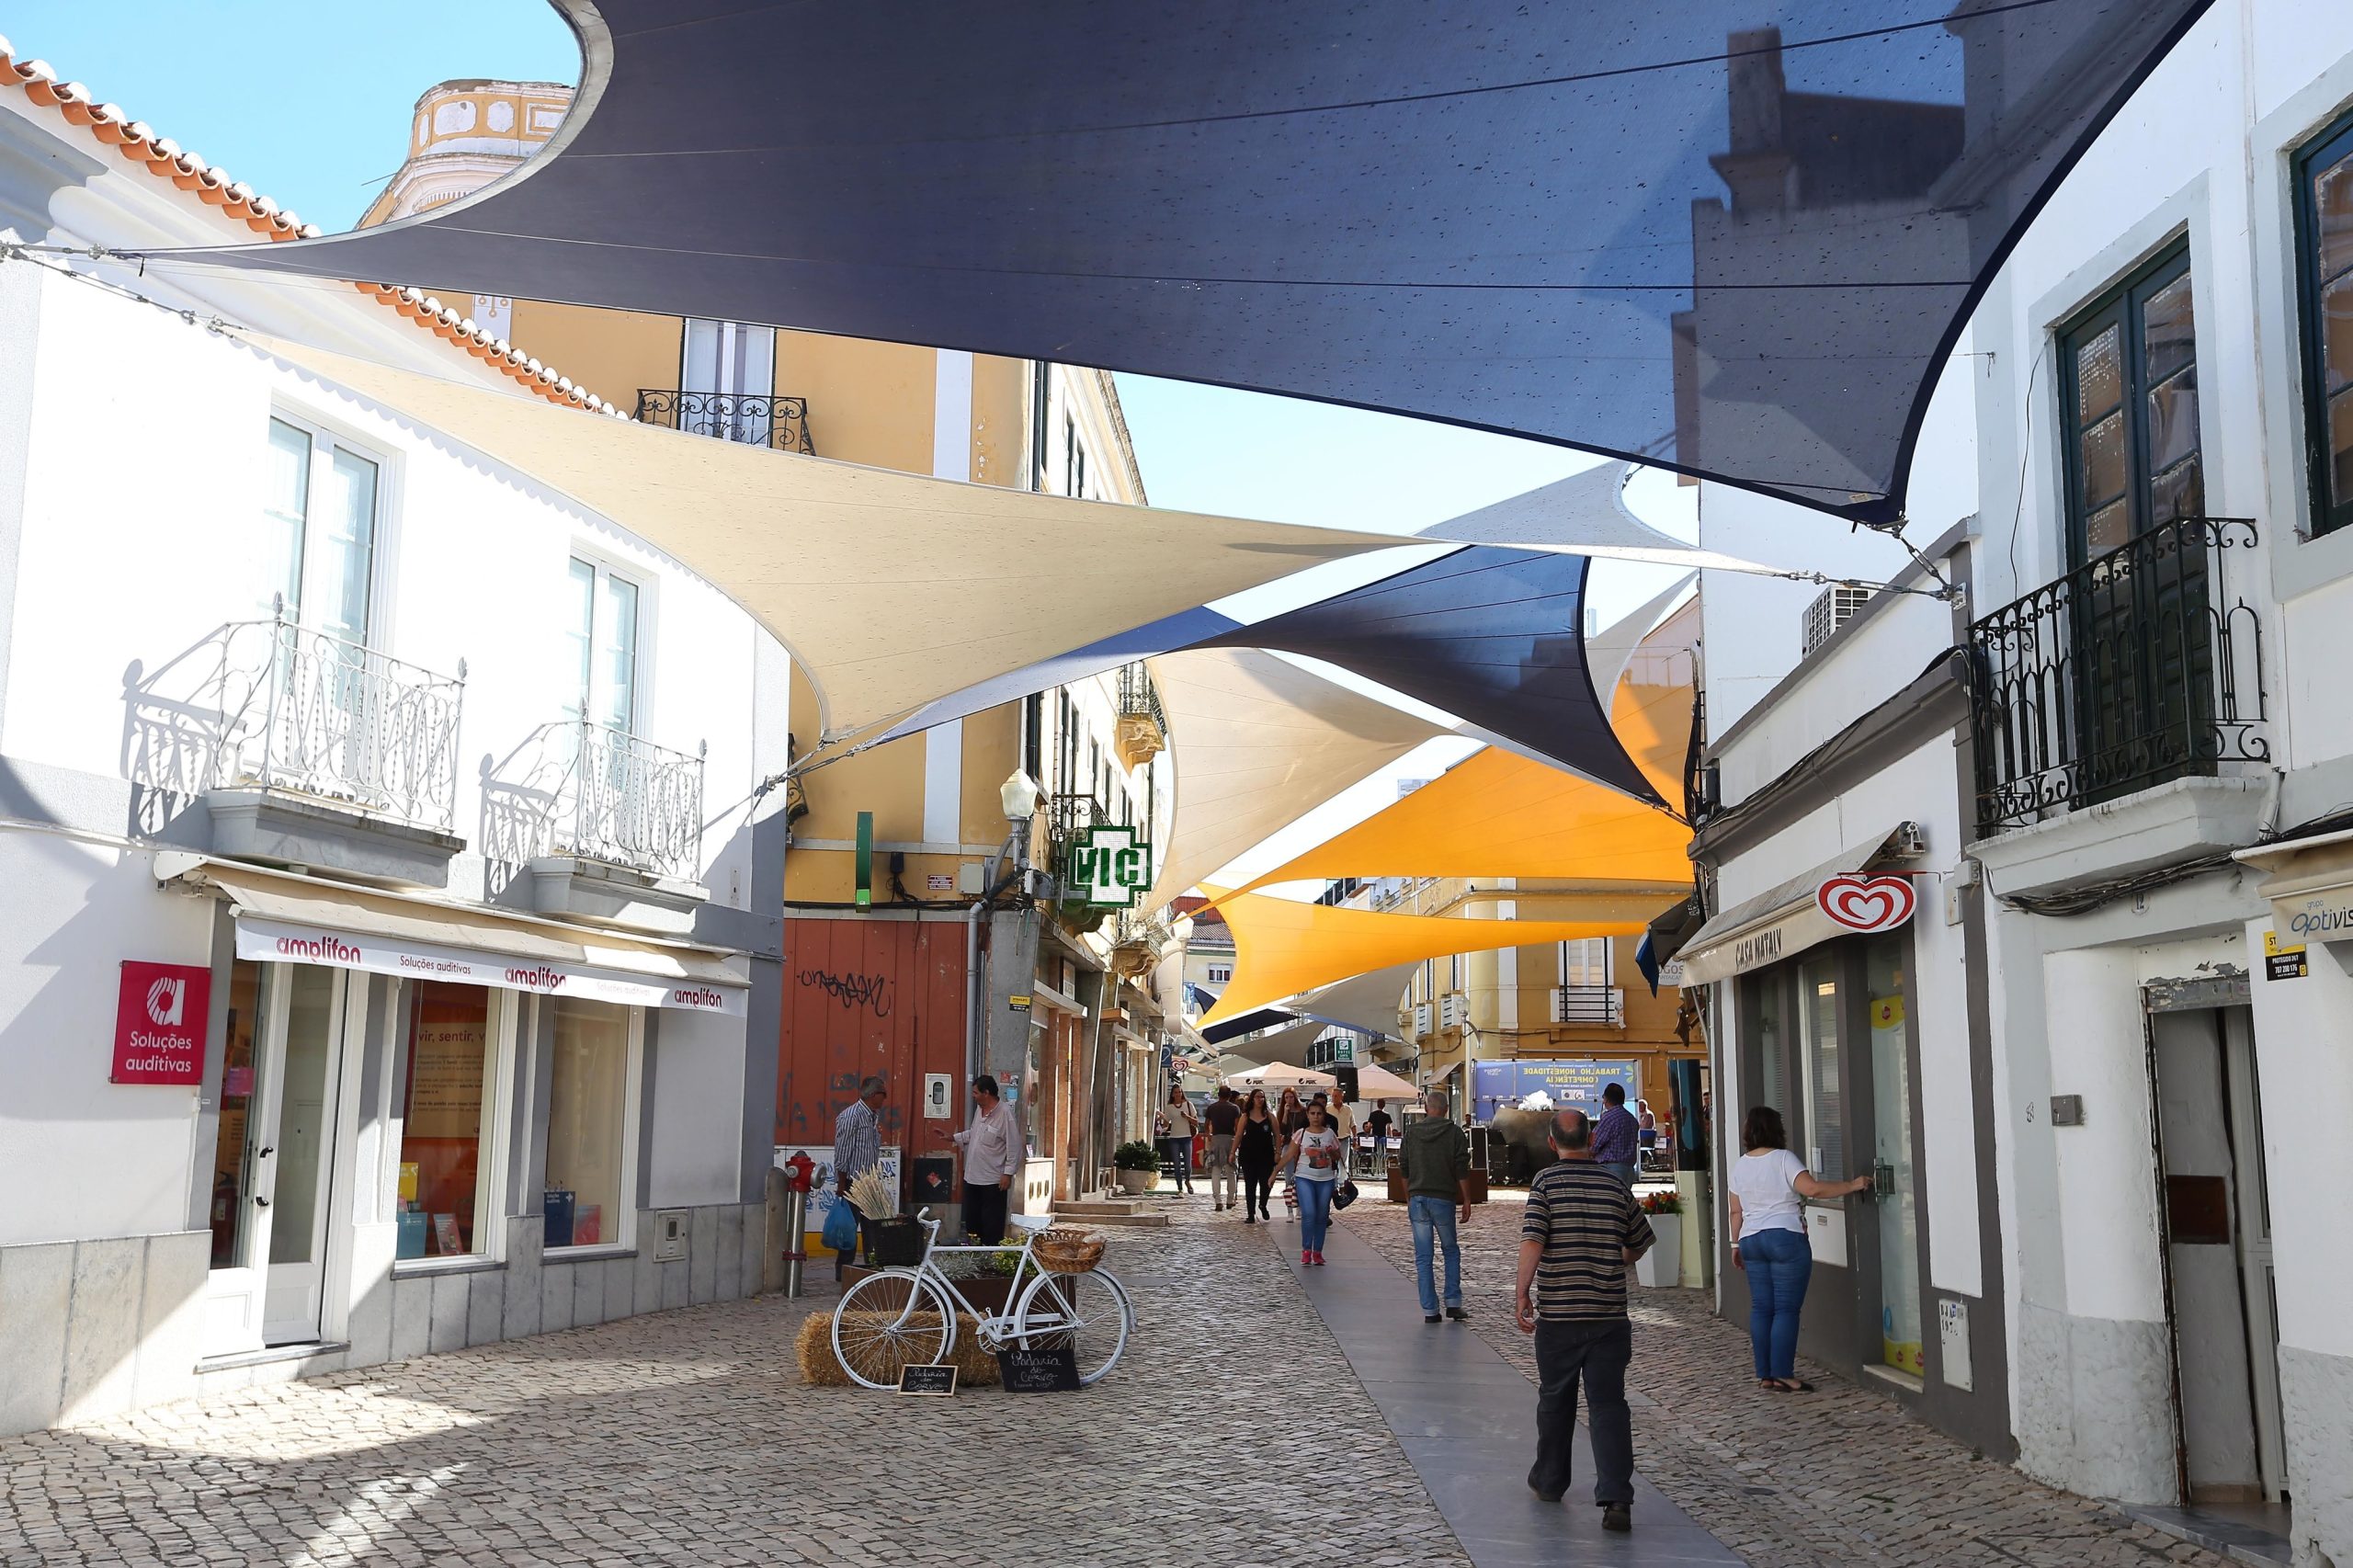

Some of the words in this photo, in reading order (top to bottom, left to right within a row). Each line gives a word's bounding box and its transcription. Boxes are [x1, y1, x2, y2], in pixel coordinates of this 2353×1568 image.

[2306, 900, 2324, 911] grupo
[276, 936, 362, 963] amplifon
[1735, 939, 1754, 971] CASA
[1755, 928, 1781, 965] NATALY
[2272, 955, 2291, 964] PROTEGIDO
[399, 955, 435, 971] Soluções
[437, 961, 472, 975] auditivas
[505, 966, 567, 991] amplifon
[674, 986, 722, 1008] amplifon
[130, 1030, 192, 1053] Soluções
[438, 1029, 474, 1043] sentir,
[125, 1055, 191, 1073] auditivas
